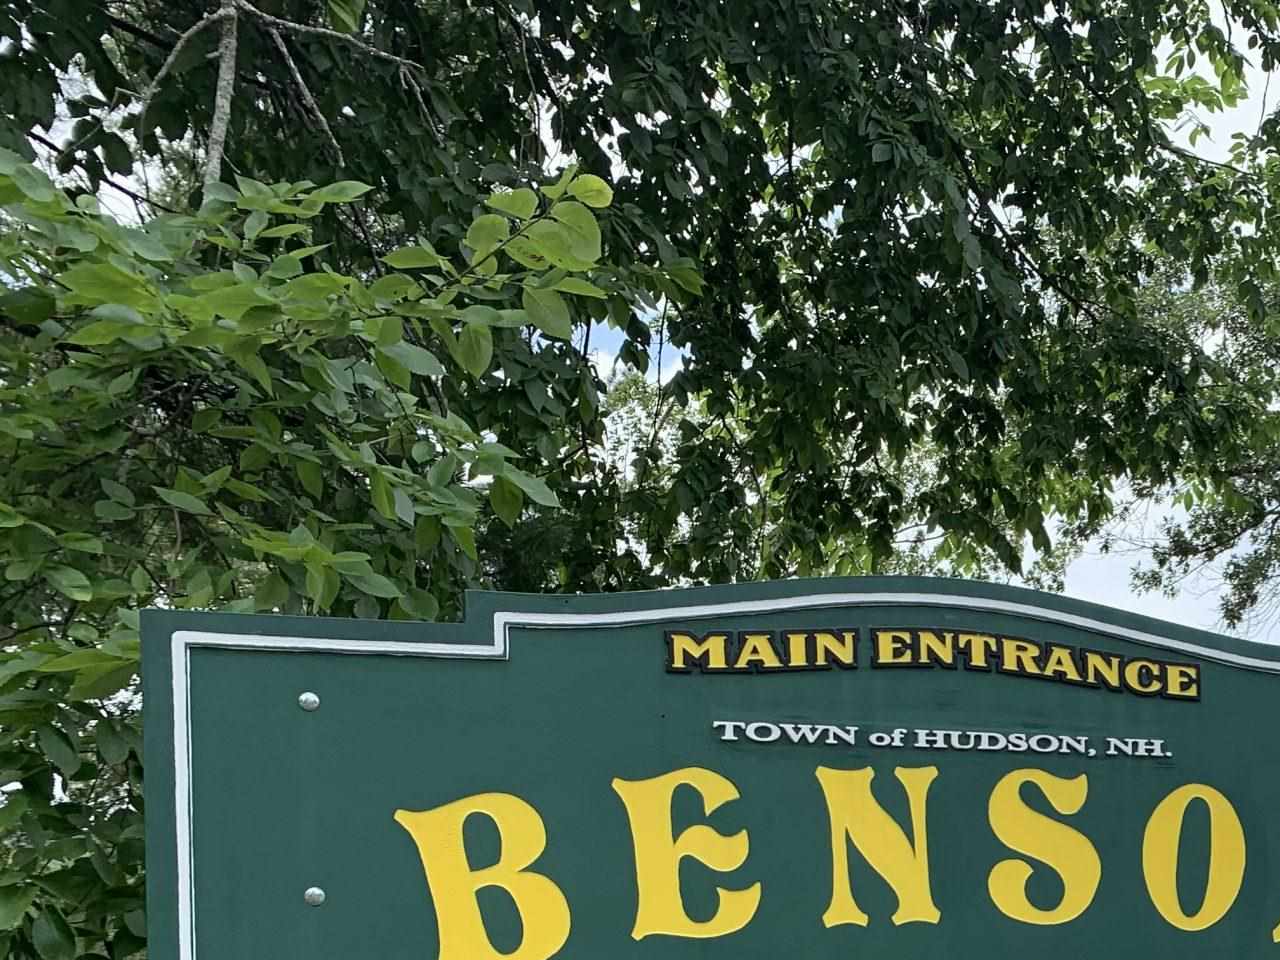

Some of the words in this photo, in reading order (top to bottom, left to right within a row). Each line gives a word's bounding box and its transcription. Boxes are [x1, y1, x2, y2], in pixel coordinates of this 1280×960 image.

[668, 631, 859, 674] MAIN
[871, 628, 1202, 700] ENTRANCE
[712, 720, 858, 746] TOWN
[868, 728, 908, 748] of
[913, 729, 1097, 757] HUDSON,
[1105, 737, 1173, 758] NH.
